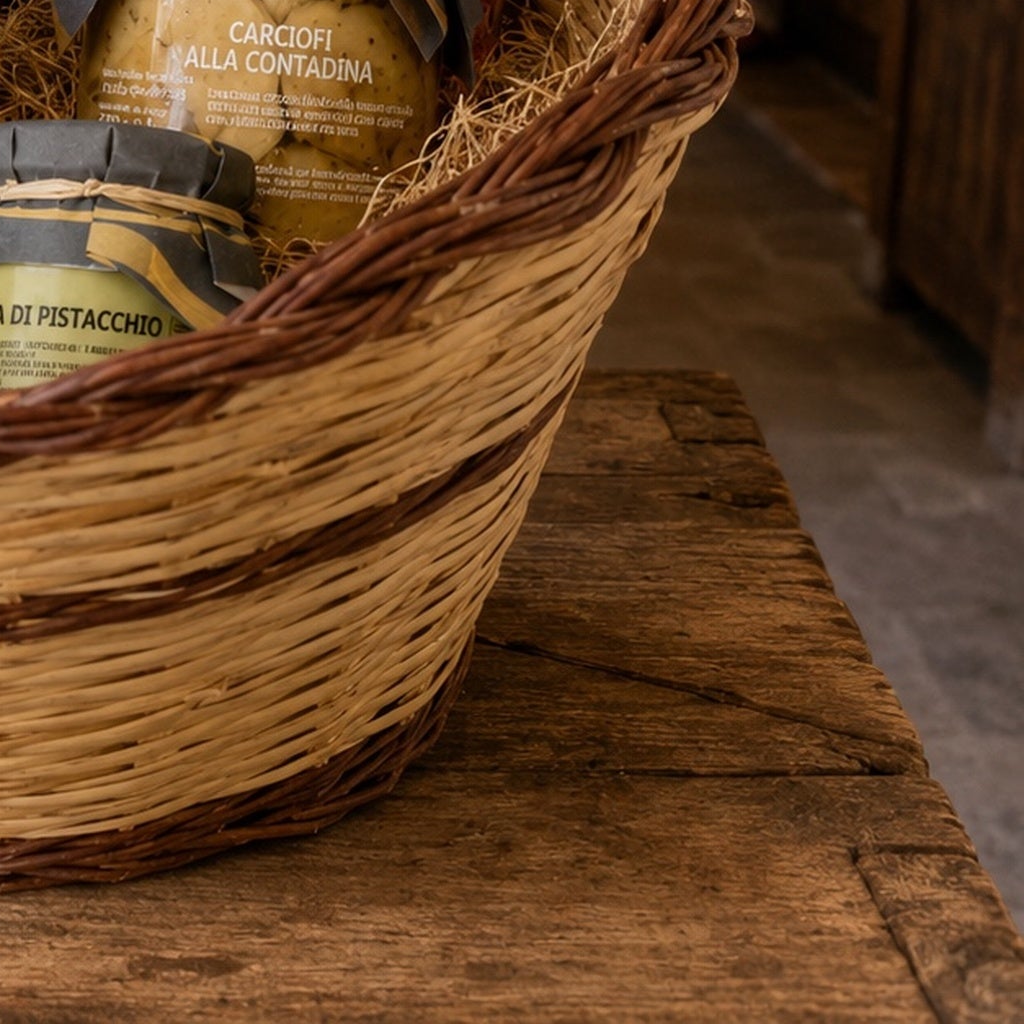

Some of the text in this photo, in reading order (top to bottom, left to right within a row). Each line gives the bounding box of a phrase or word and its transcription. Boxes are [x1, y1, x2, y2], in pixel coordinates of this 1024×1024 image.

[229, 21, 332, 52] CARCIOFI
[183, 45, 373, 85] ALLA CONTADINA
[10, 304, 33, 326] DI
[37, 306, 163, 337] PISTACCHIO
